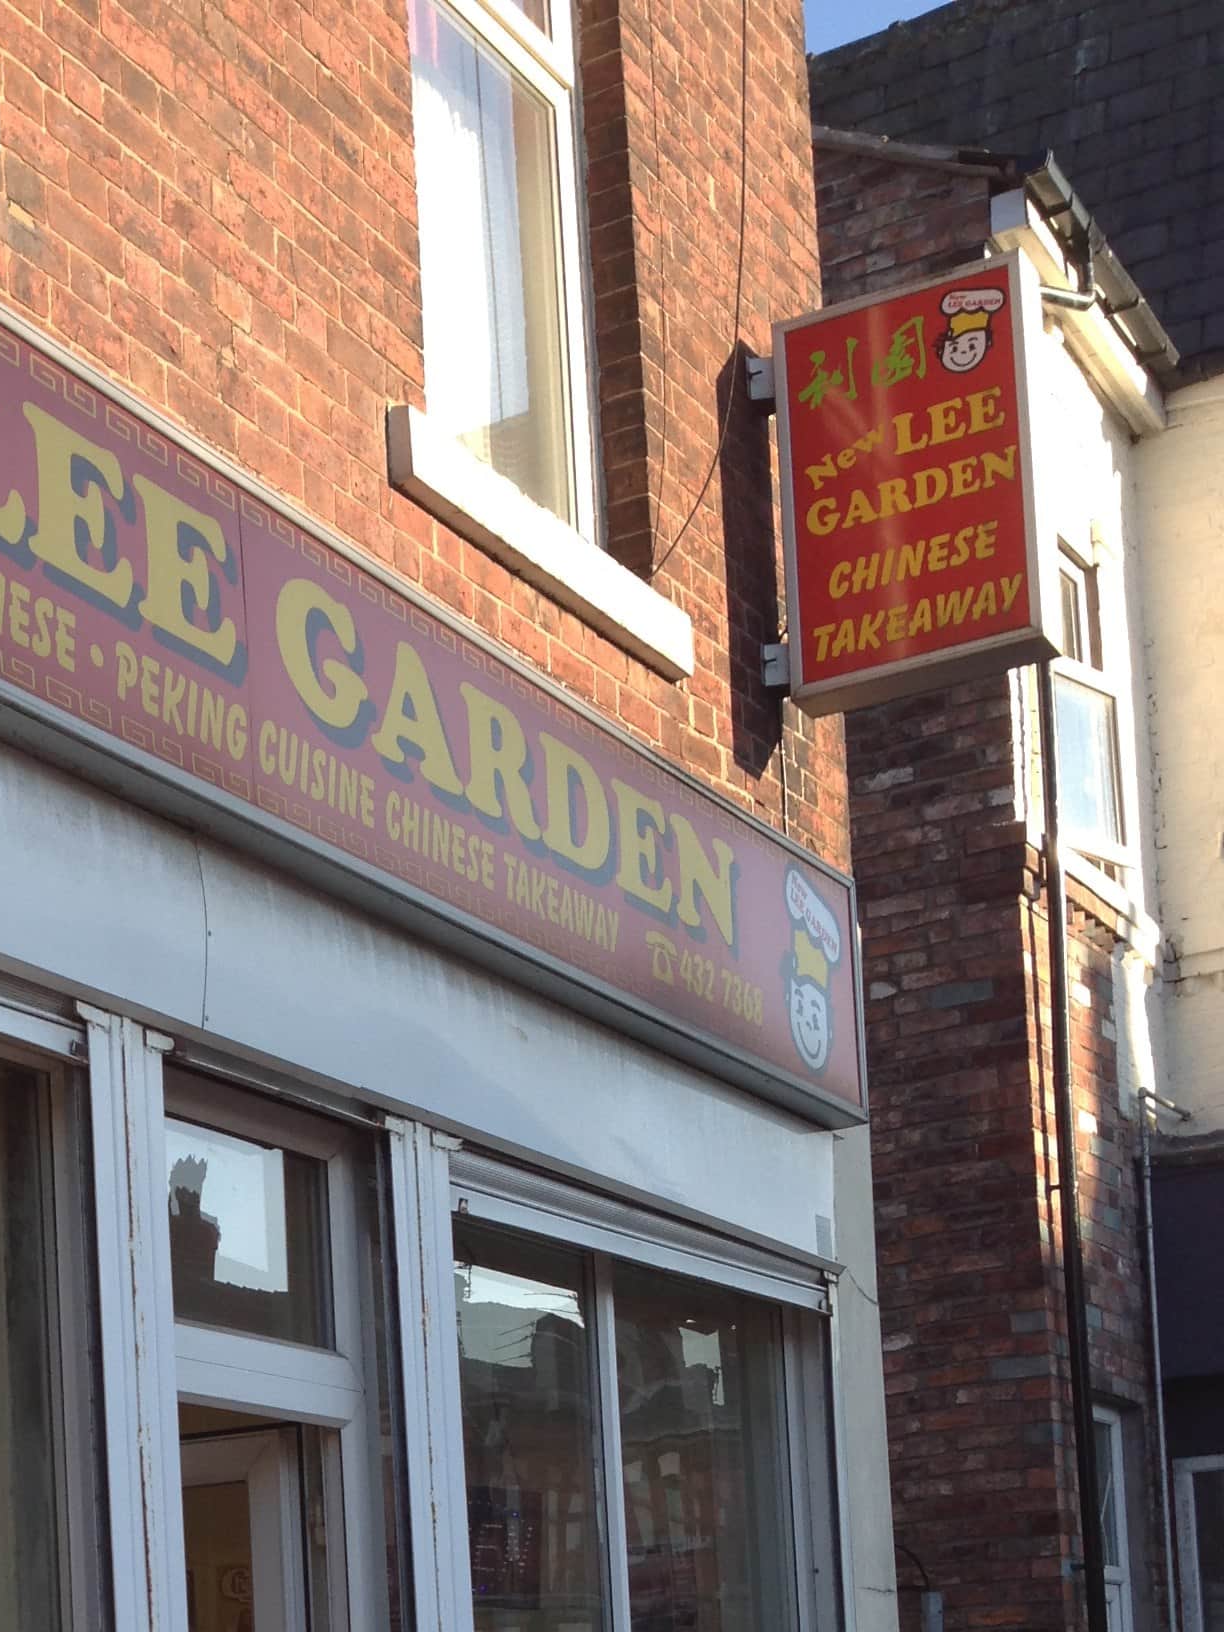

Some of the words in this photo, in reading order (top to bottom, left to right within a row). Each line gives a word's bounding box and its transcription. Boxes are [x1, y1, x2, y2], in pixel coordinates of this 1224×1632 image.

[805, 423, 887, 490] New
[892, 386, 1006, 456] LEE
[806, 445, 1018, 537] GARDEN
[829, 520, 998, 600] CHINESE
[813, 573, 1024, 663] TAKEAWAY
[116, 642, 248, 760] PEKING
[259, 719, 376, 829] CUISINE
[385, 790, 495, 891] CHINESE
[503, 852, 621, 954] TAKEAWAY
[276, 578, 737, 952] GARDEN
[679, 948, 714, 1003] 432
